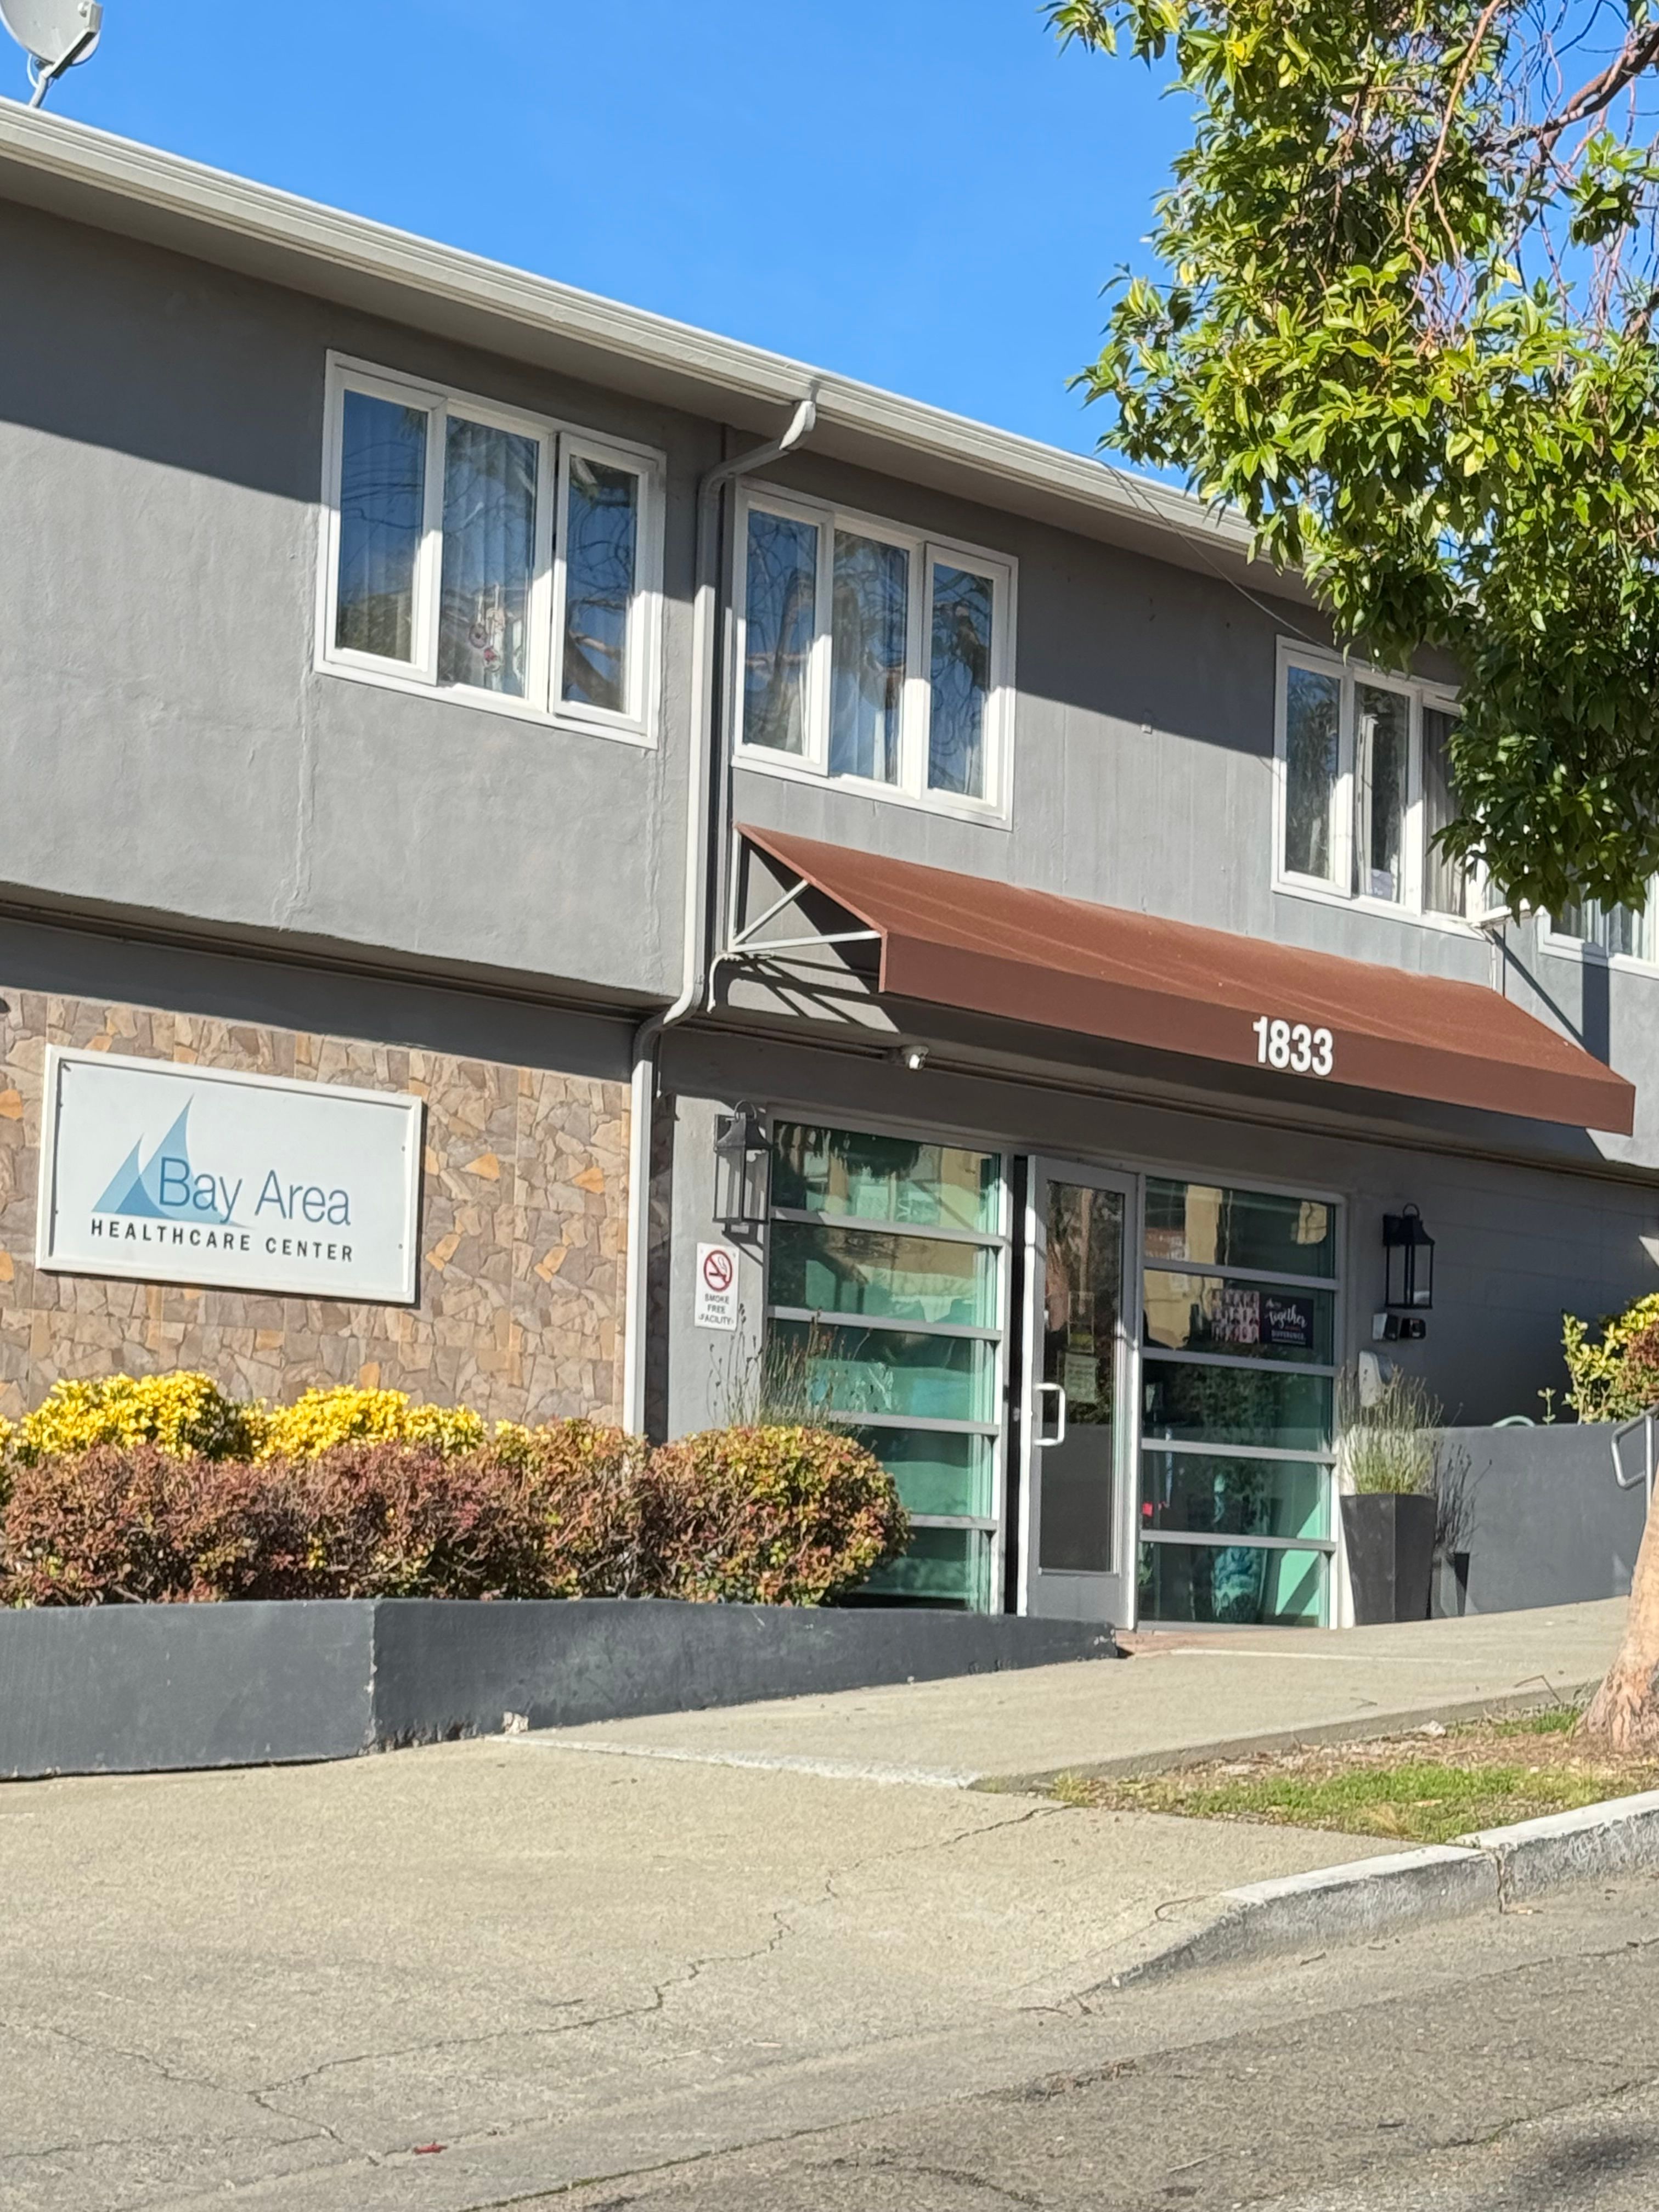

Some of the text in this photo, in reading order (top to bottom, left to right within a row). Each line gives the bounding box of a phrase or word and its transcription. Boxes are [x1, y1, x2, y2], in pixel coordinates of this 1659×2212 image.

[1252, 1016, 1333, 1076] 1833
[159, 1156, 351, 1226] Bay Area
[91, 1218, 353, 1262] HEALTHCARE CENTER
[704, 1293, 729, 1305] SMOKE
[707, 1304, 725, 1313] FREE
[699, 1313, 732, 1325] FACILITY
